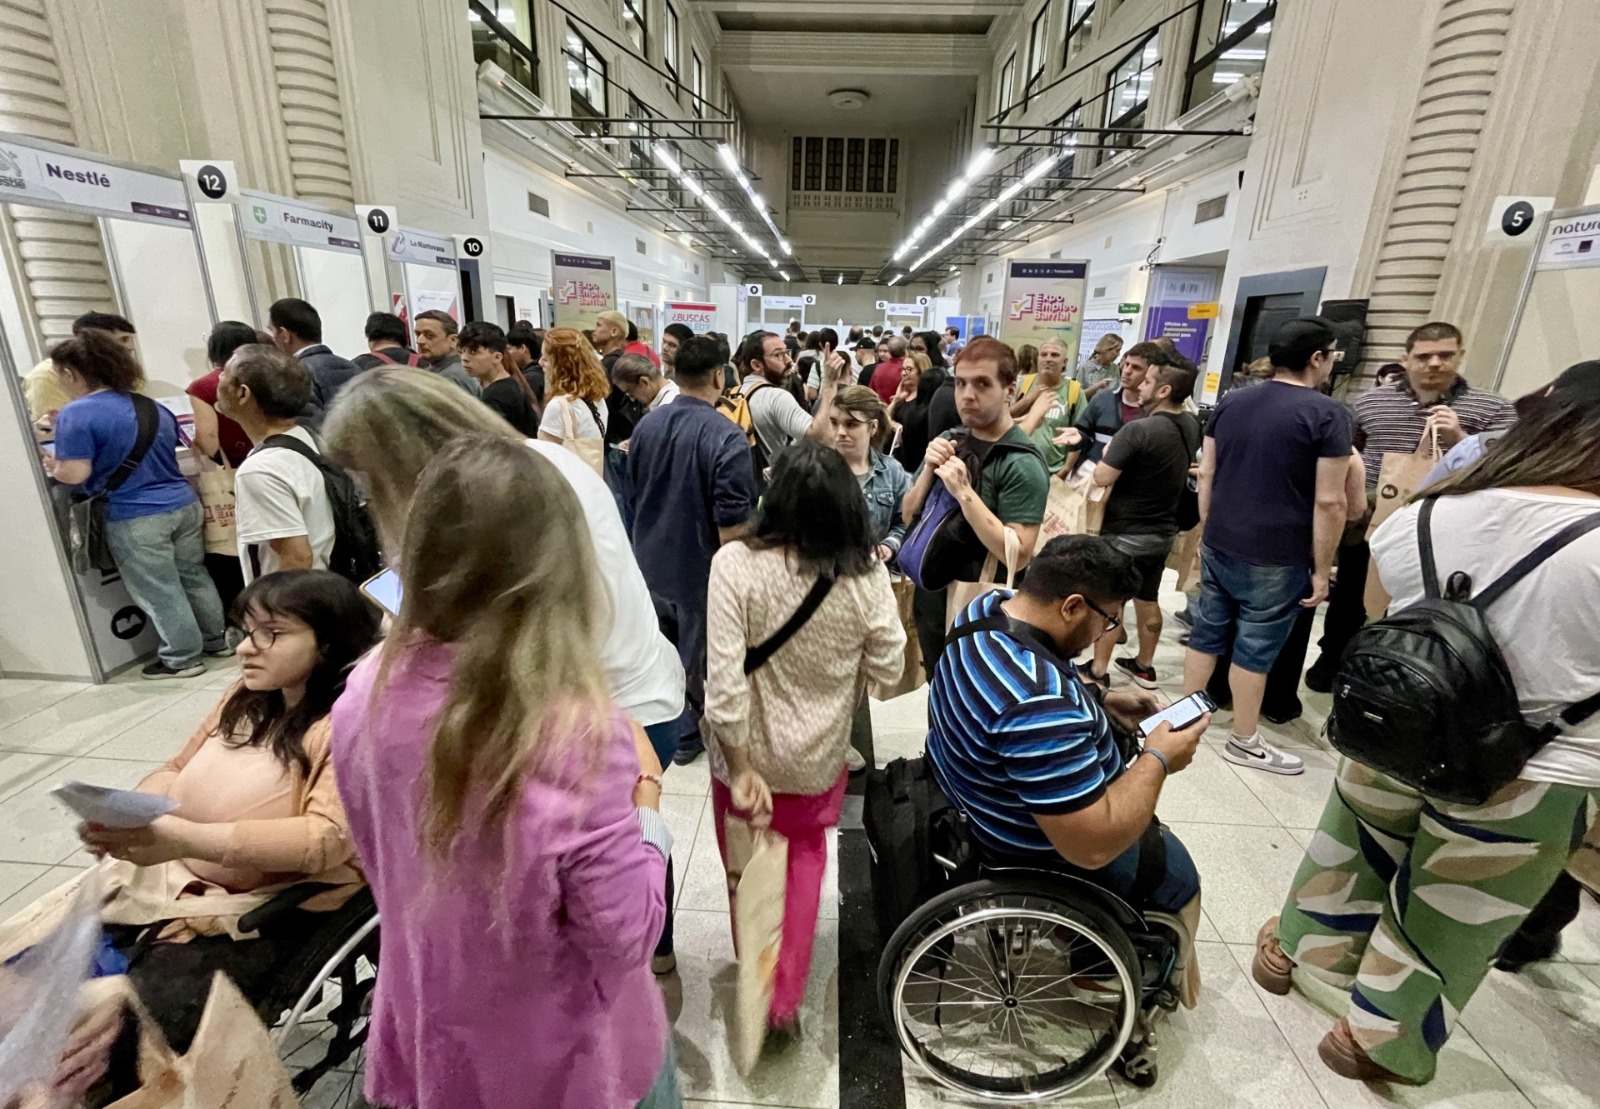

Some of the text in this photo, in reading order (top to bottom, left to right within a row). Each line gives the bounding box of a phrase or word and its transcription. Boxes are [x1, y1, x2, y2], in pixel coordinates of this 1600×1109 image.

[46, 163, 111, 188] Nestlé
[203, 175, 222, 190] 12
[283, 212, 334, 233] Farmacity
[372, 216, 384, 227] 11
[1512, 211, 1525, 226] 5
[467, 242, 480, 253] 10
[1036, 293, 1065, 304] Expo
[1035, 303, 1078, 313] Empleo
[672, 312, 710, 323] ¿BUSCÁS
[1034, 312, 1071, 322] Barrial
